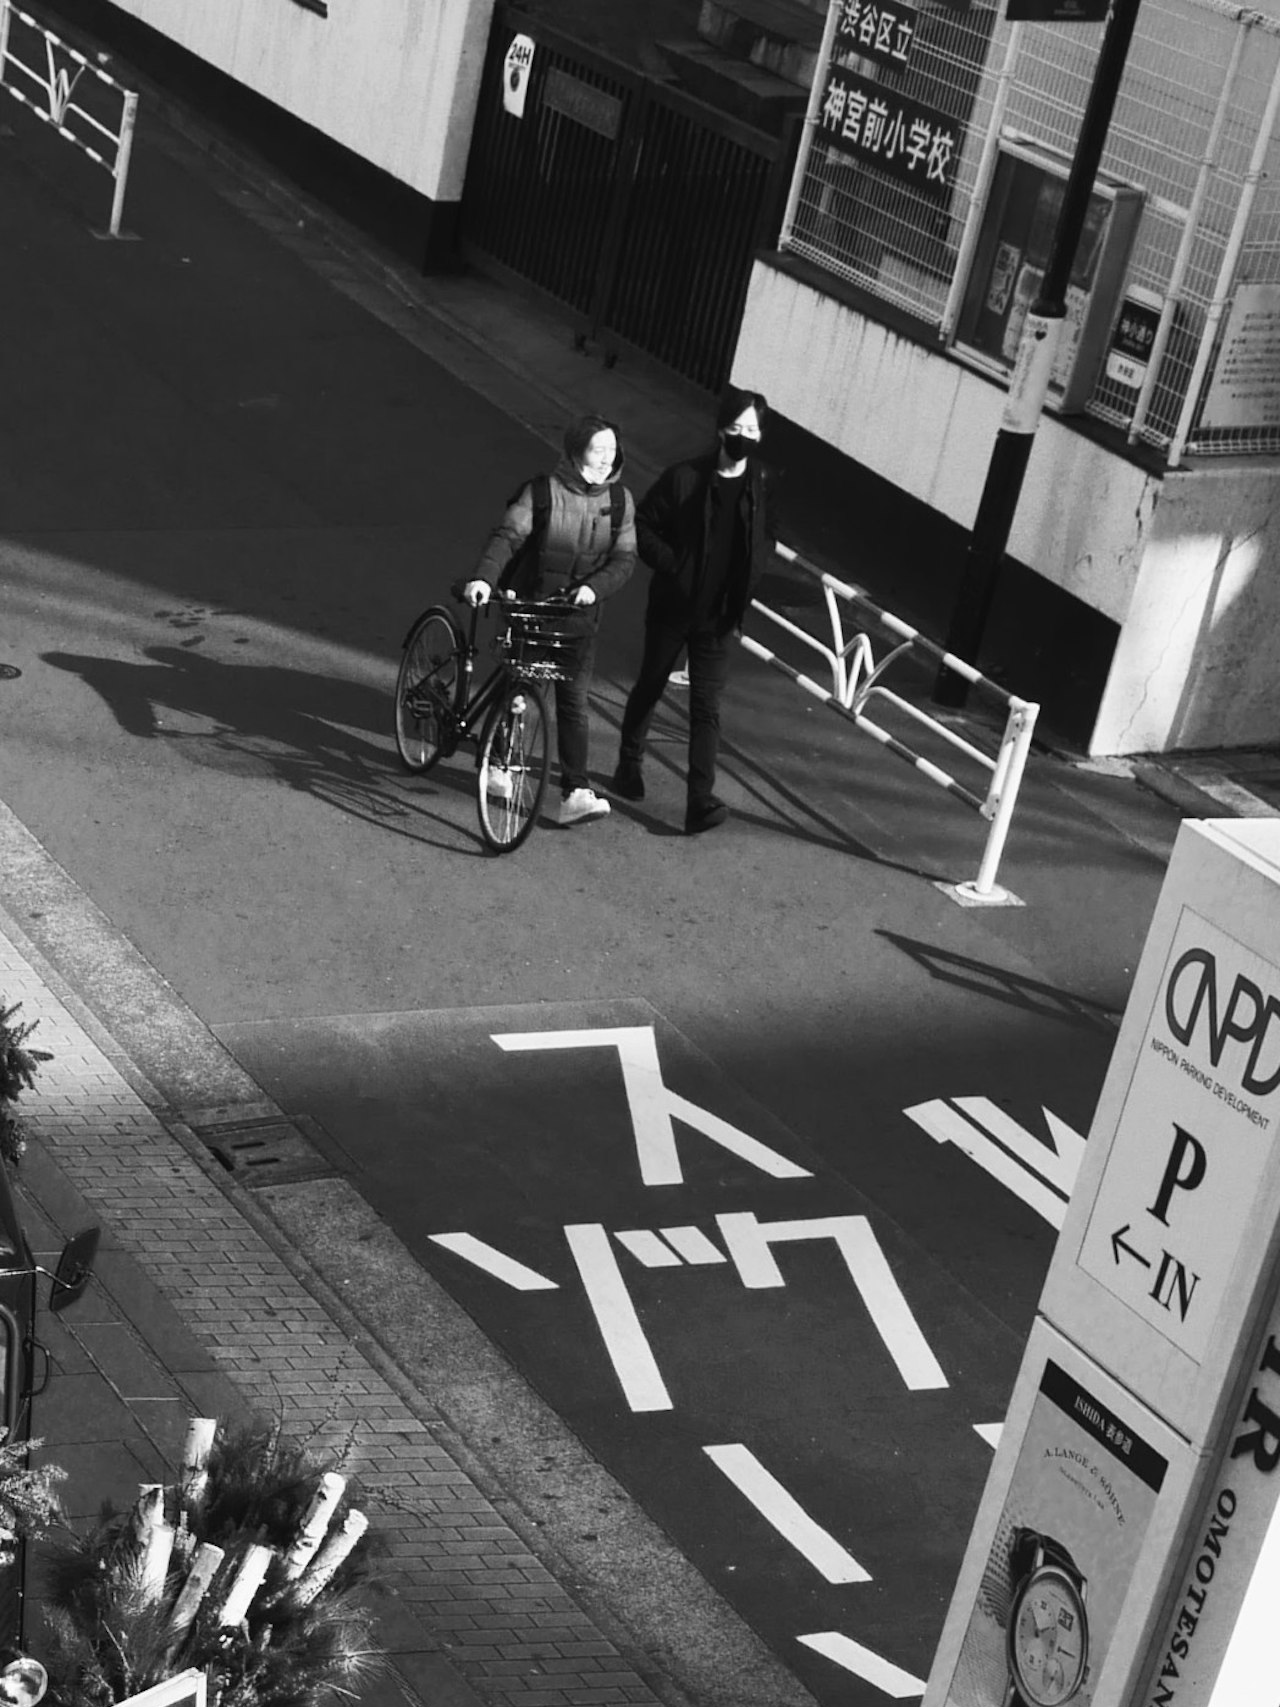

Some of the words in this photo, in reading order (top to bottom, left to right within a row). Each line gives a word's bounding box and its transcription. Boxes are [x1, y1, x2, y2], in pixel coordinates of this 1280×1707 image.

[509, 42, 532, 66] 24H
[840, 0, 913, 61] 渋谷区立
[822, 78, 954, 183] 神宮前小学校
[1152, 1037, 1179, 1066] NIPPON
[1180, 1058, 1214, 1090] PARKING
[1213, 1082, 1270, 1130] DEVELOPMENT
[1146, 1122, 1207, 1228] P
[1148, 1249, 1201, 1323] IN
[1074, 1396, 1107, 1432] ISHIDA
[1054, 1446, 1089, 1469] LANGE
